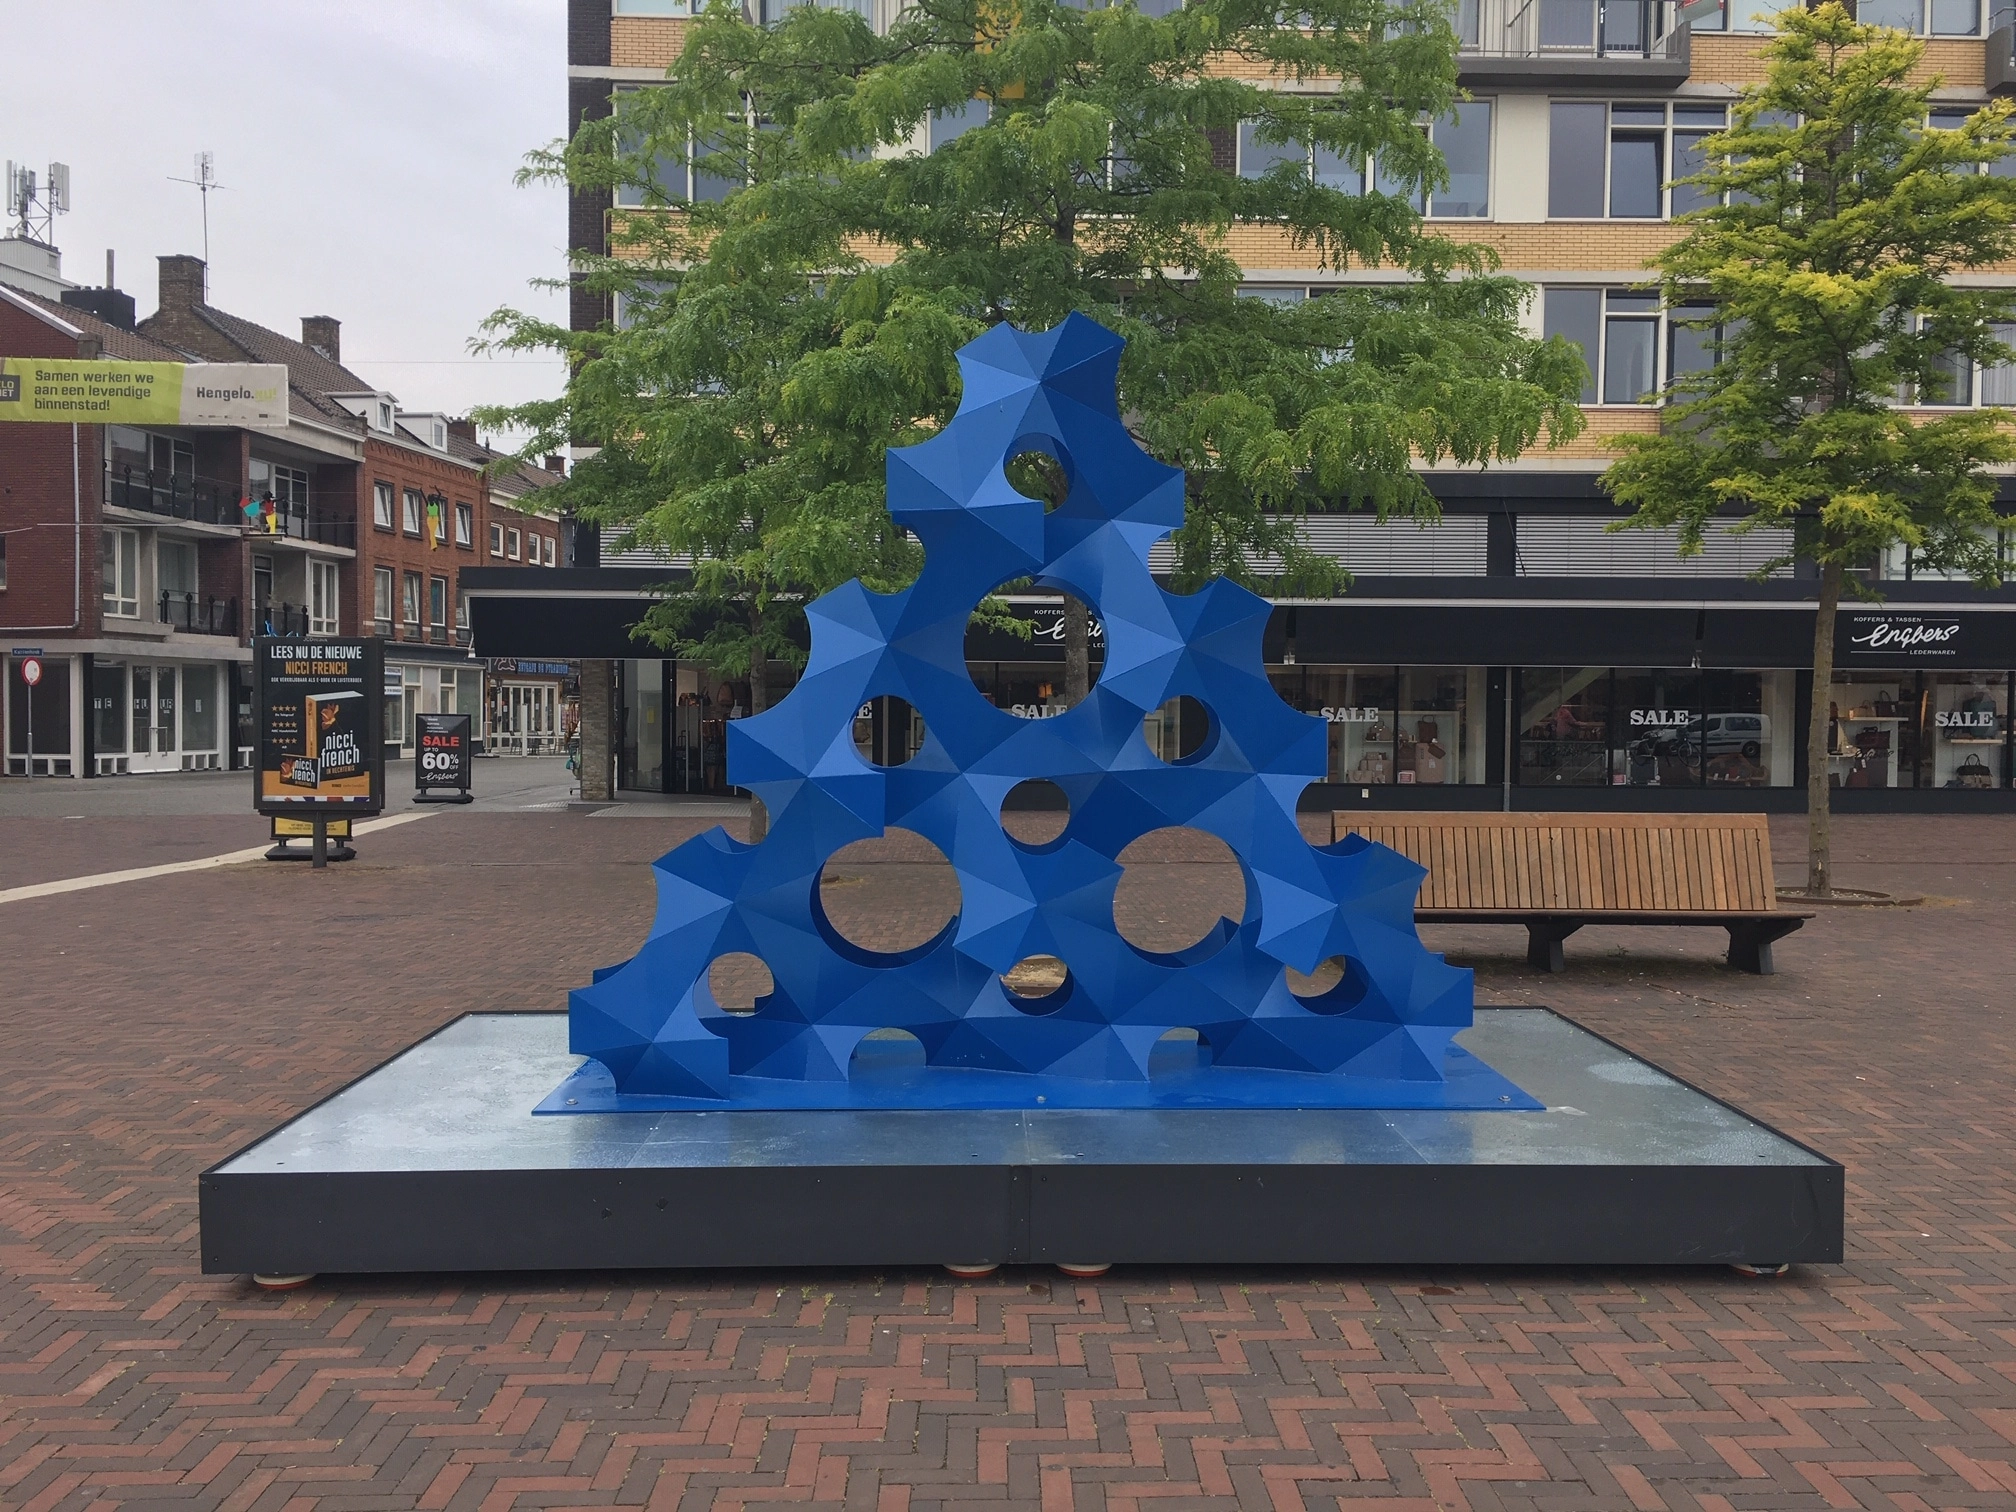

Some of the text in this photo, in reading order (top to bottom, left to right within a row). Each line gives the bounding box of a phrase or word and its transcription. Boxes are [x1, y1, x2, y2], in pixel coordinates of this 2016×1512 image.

[35, 370, 154, 383] Samen werken we
[34, 385, 151, 399] aan een levendige
[34, 398, 110, 410] binnenstad!
[1852, 623, 1959, 648] Engbers
[271, 645, 362, 659] LEES NU DE NIEUWE
[285, 661, 348, 675] NICCI FRENCH
[1320, 707, 1379, 722] SALE
[1630, 709, 1689, 725] SALE
[1935, 711, 1993, 727] SALE
[325, 730, 353, 750] nicci
[422, 735, 459, 747] SALE
[321, 744, 360, 768] french
[422, 752, 459, 769] 60%
[294, 758, 312, 770] nicci
[292, 767, 316, 783] french
